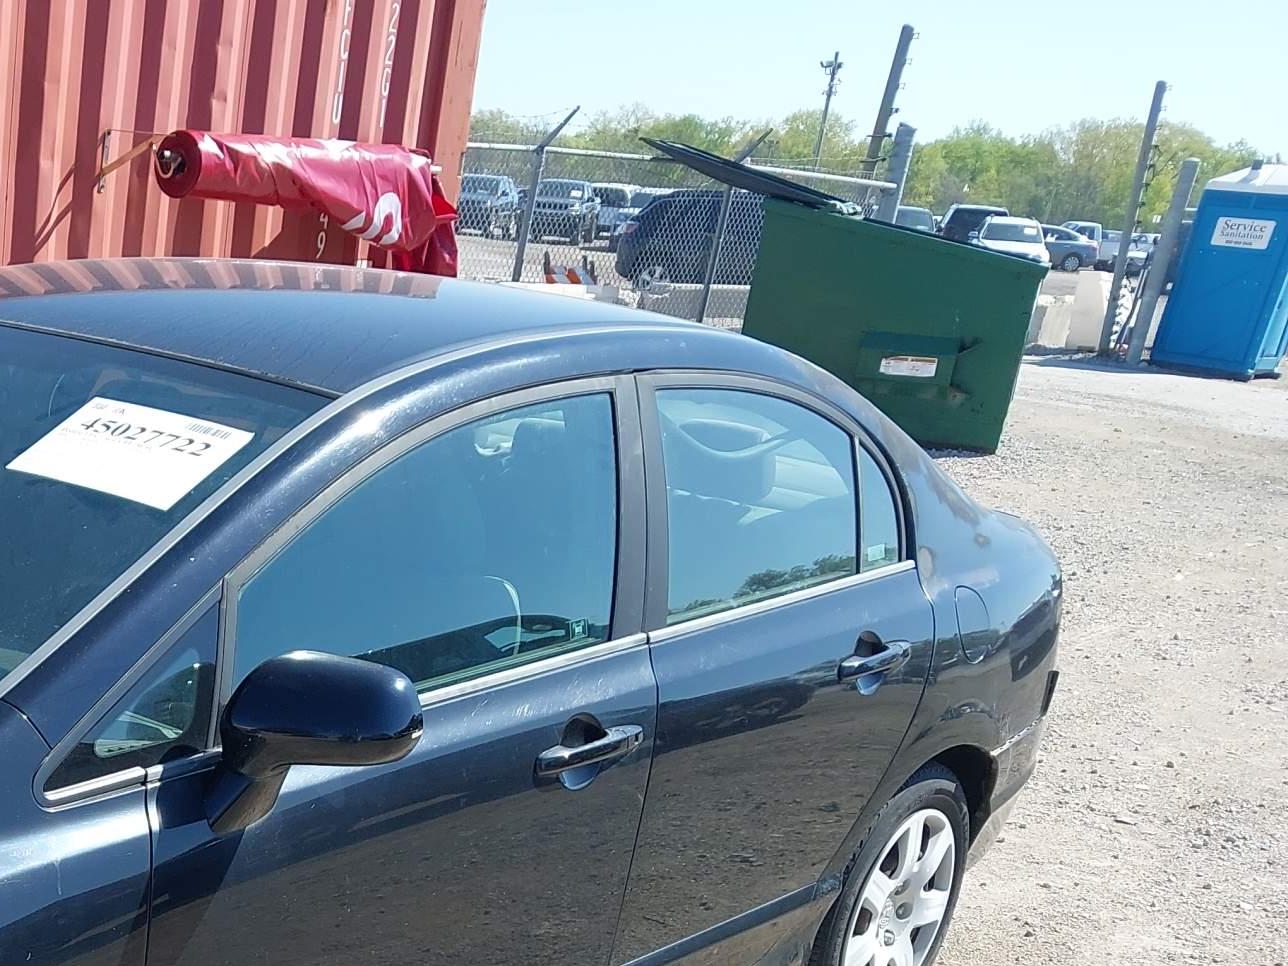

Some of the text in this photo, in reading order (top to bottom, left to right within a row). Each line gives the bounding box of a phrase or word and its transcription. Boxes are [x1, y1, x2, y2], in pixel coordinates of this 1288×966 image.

[1223, 219, 1268, 233] Service
[1220, 230, 1264, 240] Sanitation
[80, 417, 212, 457] 45027722
